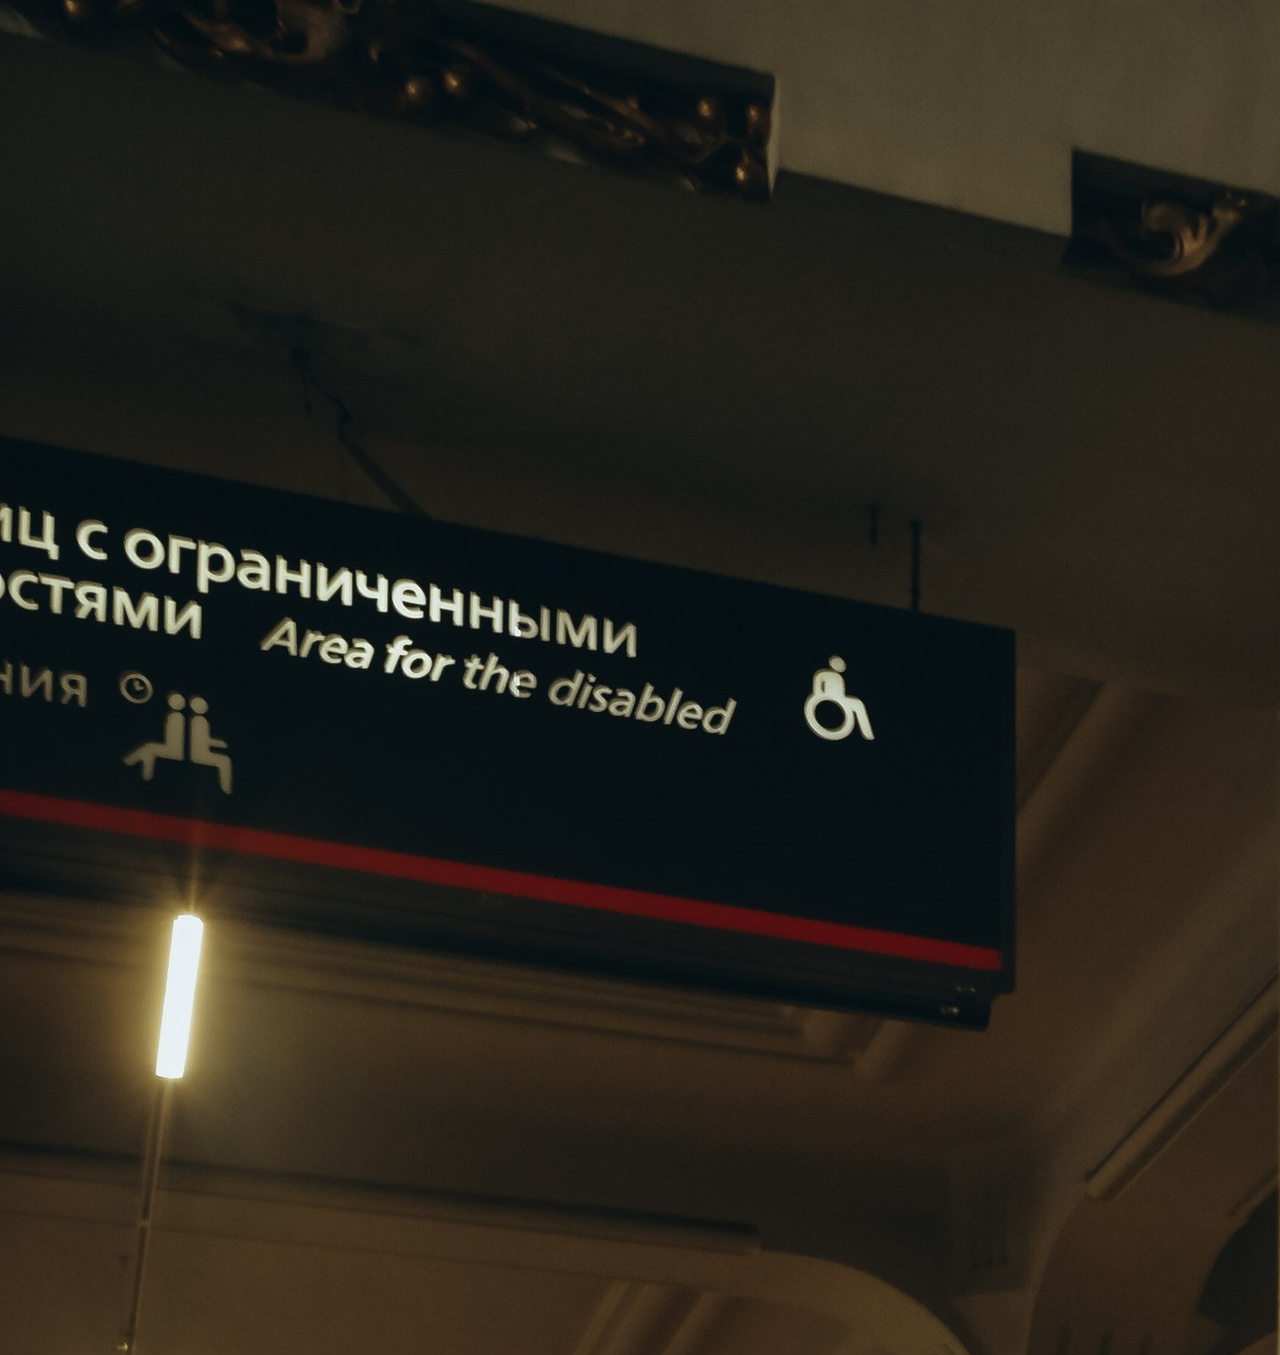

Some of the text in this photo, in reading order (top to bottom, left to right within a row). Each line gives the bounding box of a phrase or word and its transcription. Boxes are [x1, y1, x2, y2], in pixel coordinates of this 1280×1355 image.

[0, 568, 203, 640] стями
[75, 518, 109, 561] с
[123, 526, 638, 659] ограниченными
[260, 616, 738, 736] Area for the disabled
